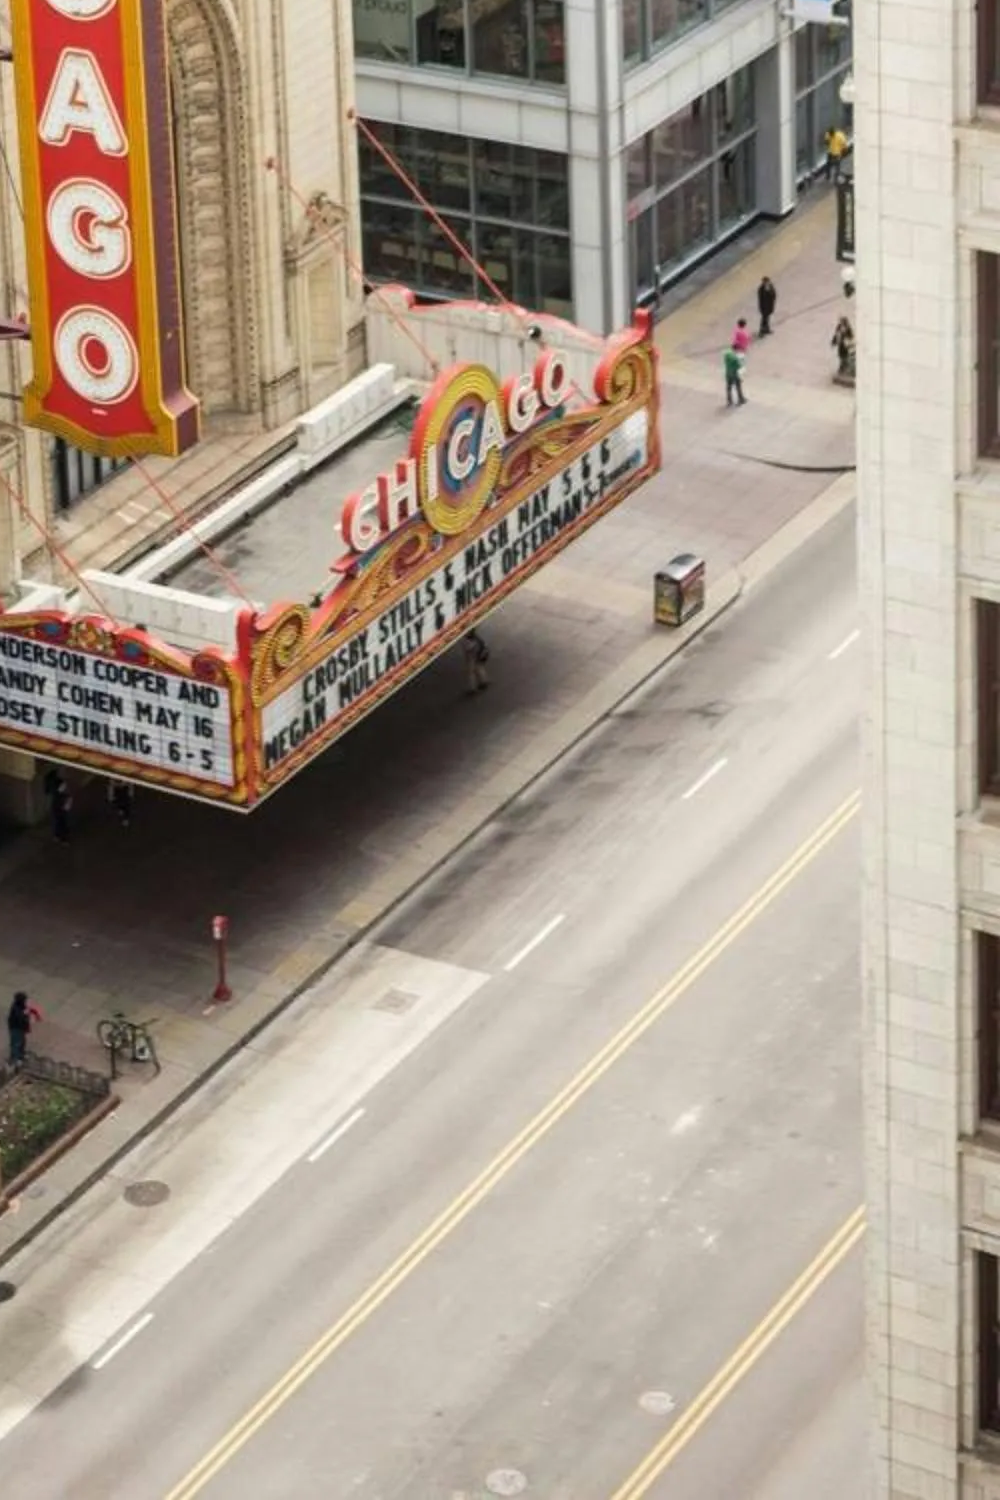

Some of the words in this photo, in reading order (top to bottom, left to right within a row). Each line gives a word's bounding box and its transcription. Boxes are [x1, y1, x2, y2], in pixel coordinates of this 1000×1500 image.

[343, 352, 569, 552] CHICAGO
[264, 696, 326, 769] MEGAN
[338, 615, 424, 708] MULLALLY
[455, 563, 492, 614] NICK
[501, 489, 583, 575] OFFERMAN
[303, 629, 369, 703] CROSBY
[378, 578, 436, 644] STILLS
[465, 519, 509, 575] NASH
[518, 484, 550, 532] MAY
[56, 713, 151, 756] STIRLING
[57, 682, 123, 717] COHEN
[136, 703, 181, 731] MAY
[194, 716, 213, 739] 16
[93, 662, 169, 696] COOPER
[178, 681, 220, 709] AND
